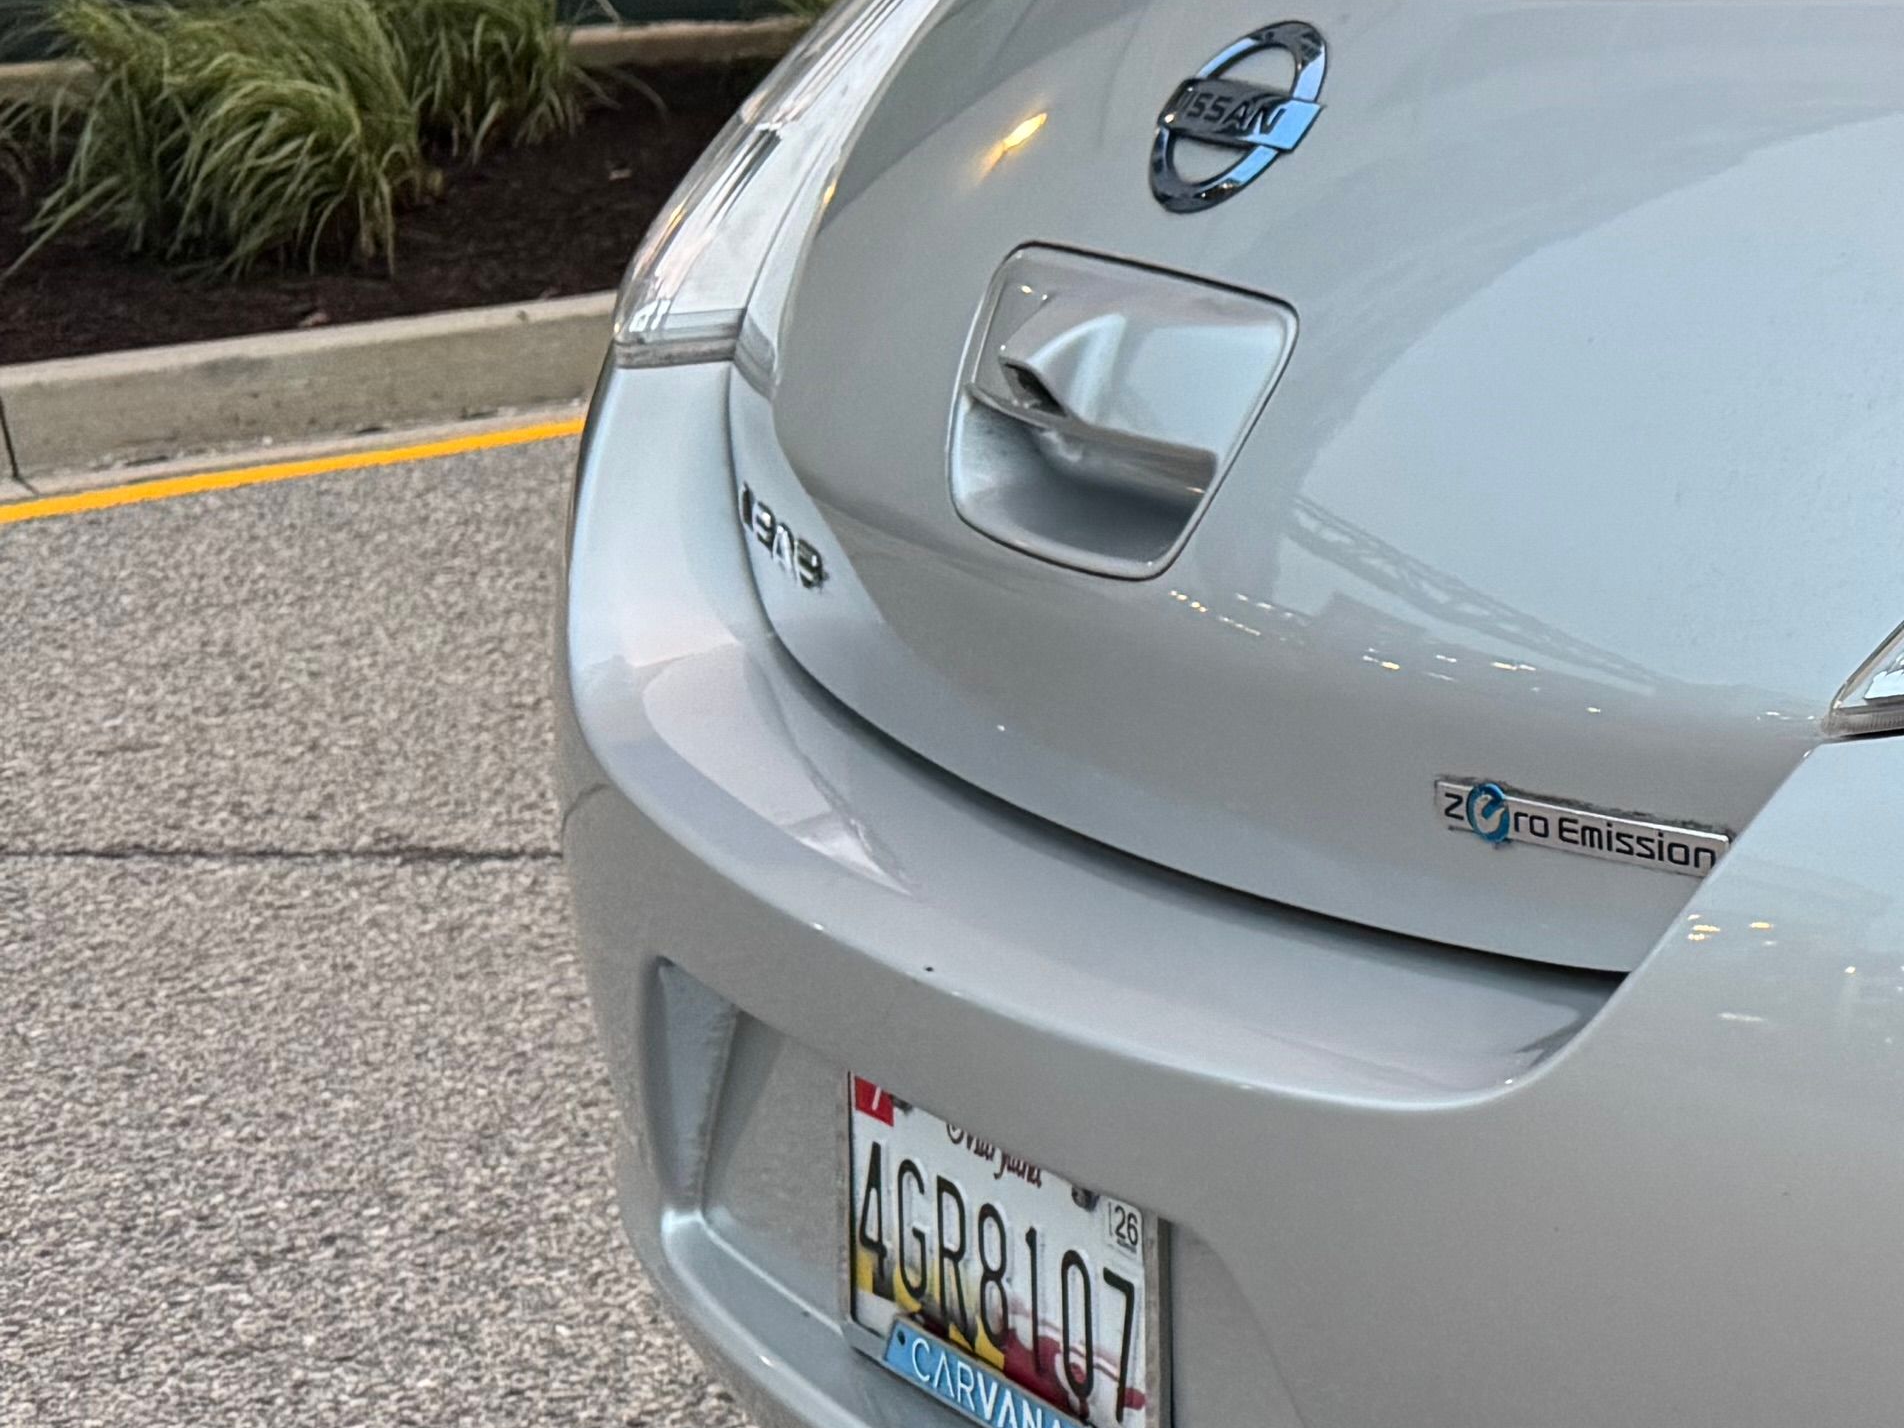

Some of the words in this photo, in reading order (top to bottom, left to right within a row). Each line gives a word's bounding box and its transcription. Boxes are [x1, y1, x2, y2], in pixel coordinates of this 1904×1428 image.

[1558, 817, 1716, 869] Emission
[1114, 1204, 1139, 1246] 26
[860, 1141, 1136, 1423] 4GR8107
